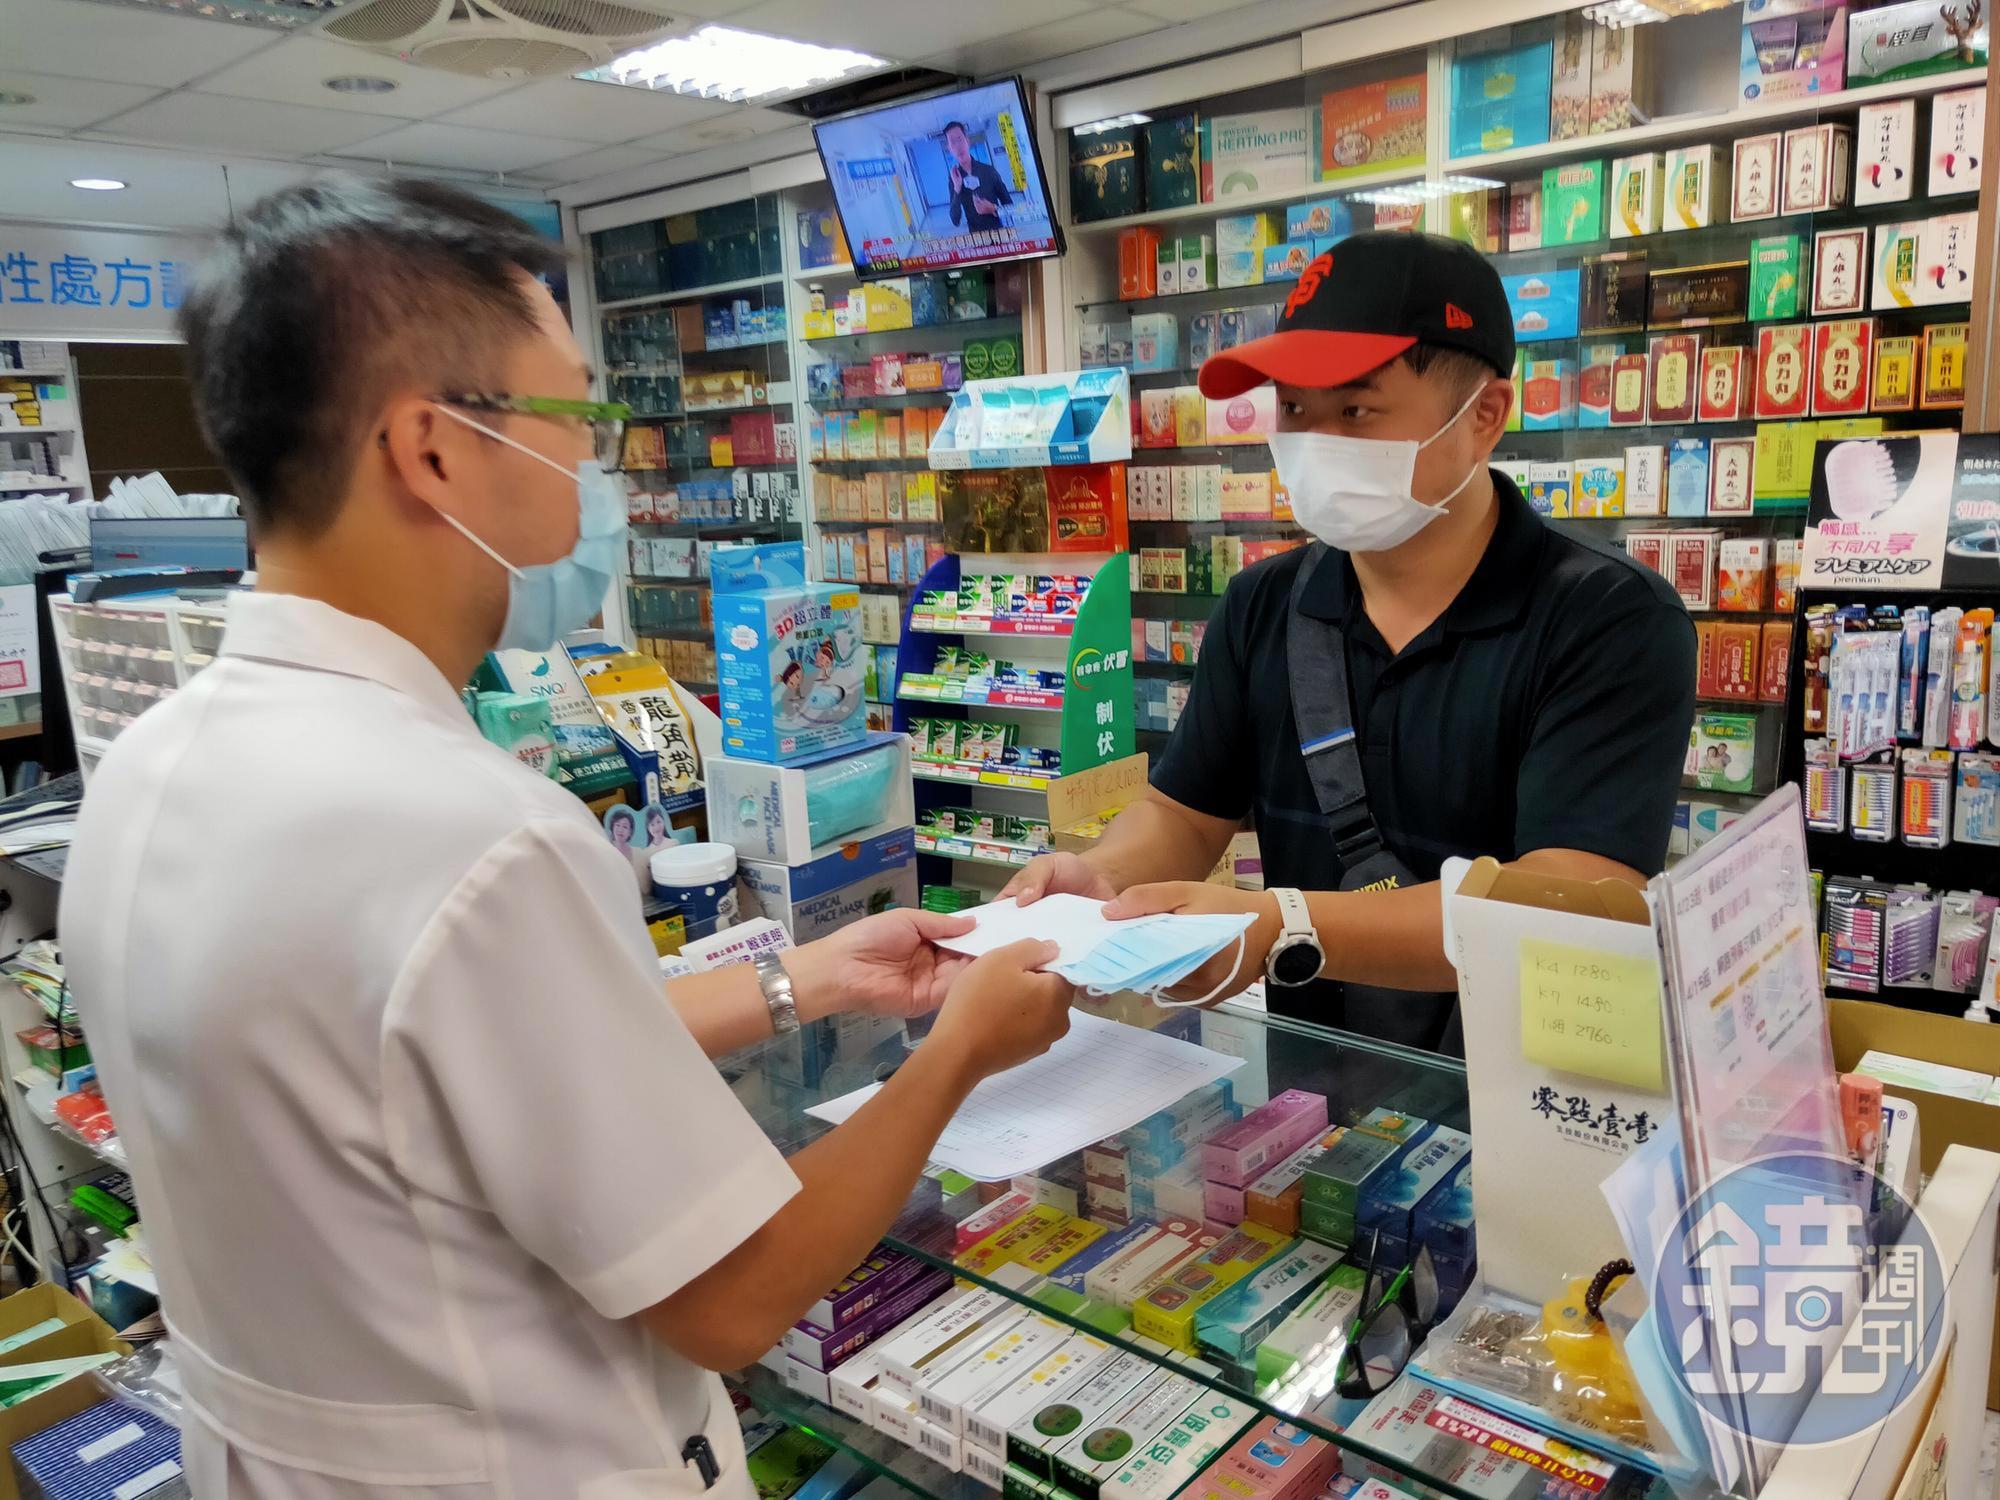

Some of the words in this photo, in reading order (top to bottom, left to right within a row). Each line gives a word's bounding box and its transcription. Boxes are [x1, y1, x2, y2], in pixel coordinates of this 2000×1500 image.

[1217, 132, 1278, 151] HEATING
[1280, 129, 1307, 144] PAD
[1814, 557, 1932, 575] プレミアムケア
[1833, 576, 1881, 585] premium
[530, 683, 566, 698] SNQ
[762, 795, 773, 824] FACE
[769, 780, 783, 829] MEDICAL
[765, 824, 777, 856] MASK
[798, 894, 842, 917] MEDICAL
[813, 907, 838, 926] FACE
[838, 899, 866, 918] MASK
